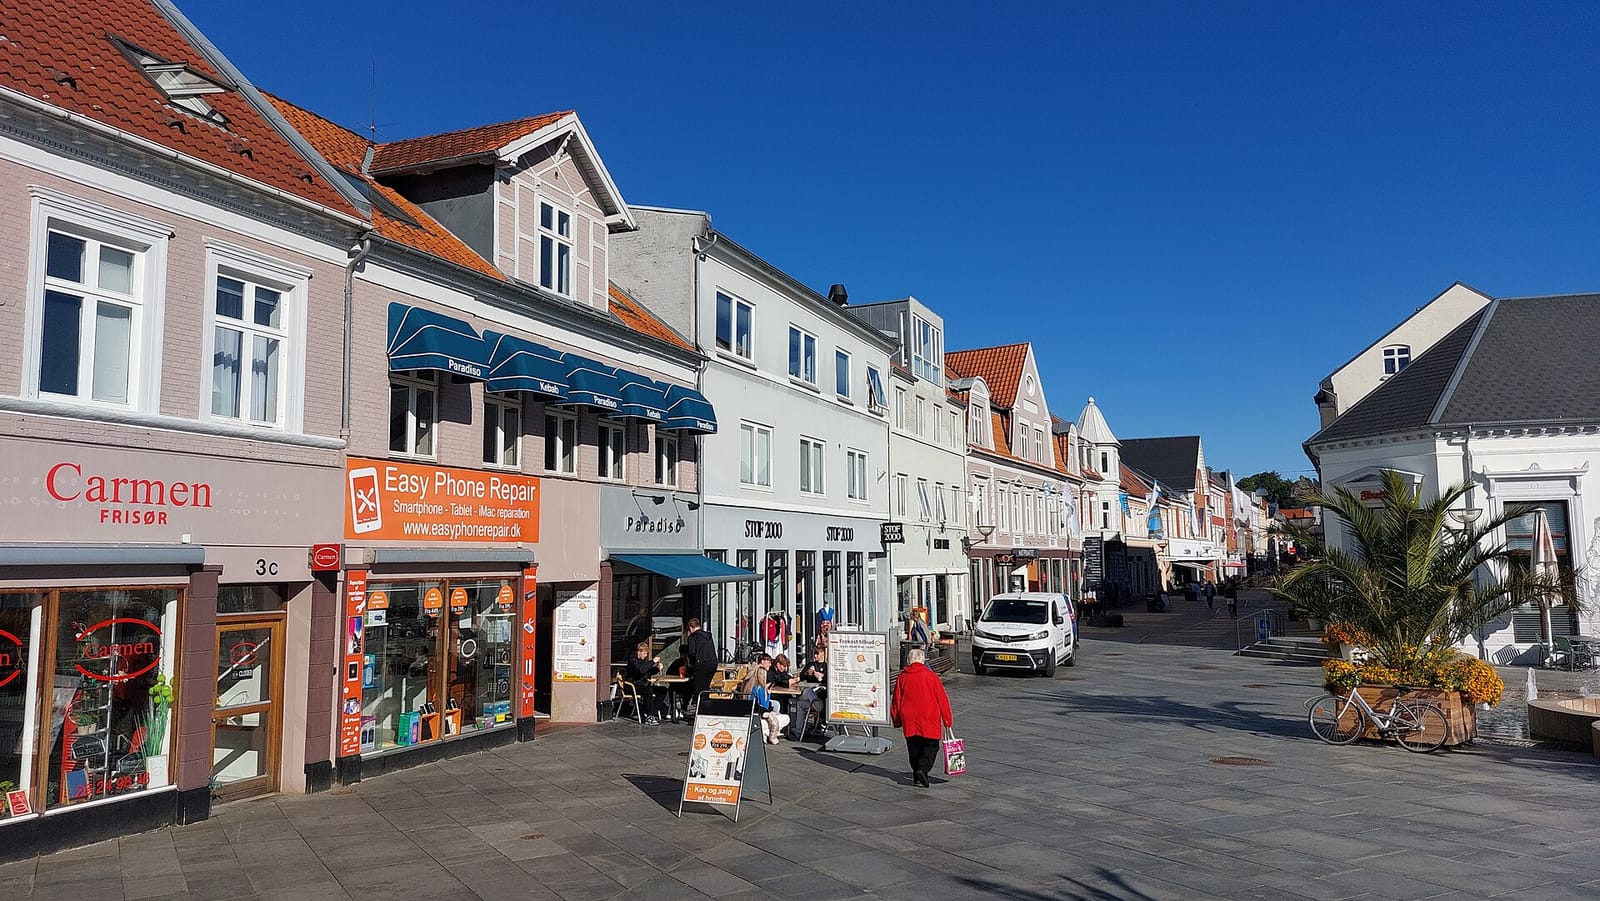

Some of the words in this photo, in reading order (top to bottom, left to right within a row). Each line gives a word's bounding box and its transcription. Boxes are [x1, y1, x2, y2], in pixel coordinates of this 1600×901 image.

[448, 359, 481, 377] Paradiso
[540, 381, 560, 394] Kebab
[594, 395, 617, 408] Paradiso
[697, 421, 714, 431] Paradiso
[46, 462, 213, 508] Carmen
[385, 466, 429, 499] Easy
[434, 472, 485, 499] Phone
[490, 477, 536, 506] Repair
[99, 509, 168, 525] FRISØR
[393, 500, 443, 516] Smartphone
[450, 503, 472, 516] Tablet
[478, 505, 495, 518] iMac
[497, 508, 530, 520] reparation
[403, 520, 521, 540] www.easyphonerepair.dk
[626, 516, 683, 533] Paradiso
[745, 520, 764, 538] STOF
[765, 521, 782, 539] 2000
[884, 525, 901, 533] STOF
[827, 526, 841, 541] STOF
[841, 528, 854, 541] 2000
[884, 533, 901, 541] 2000
[85, 642, 154, 659] Carmen
[708, 787, 717, 795] og
